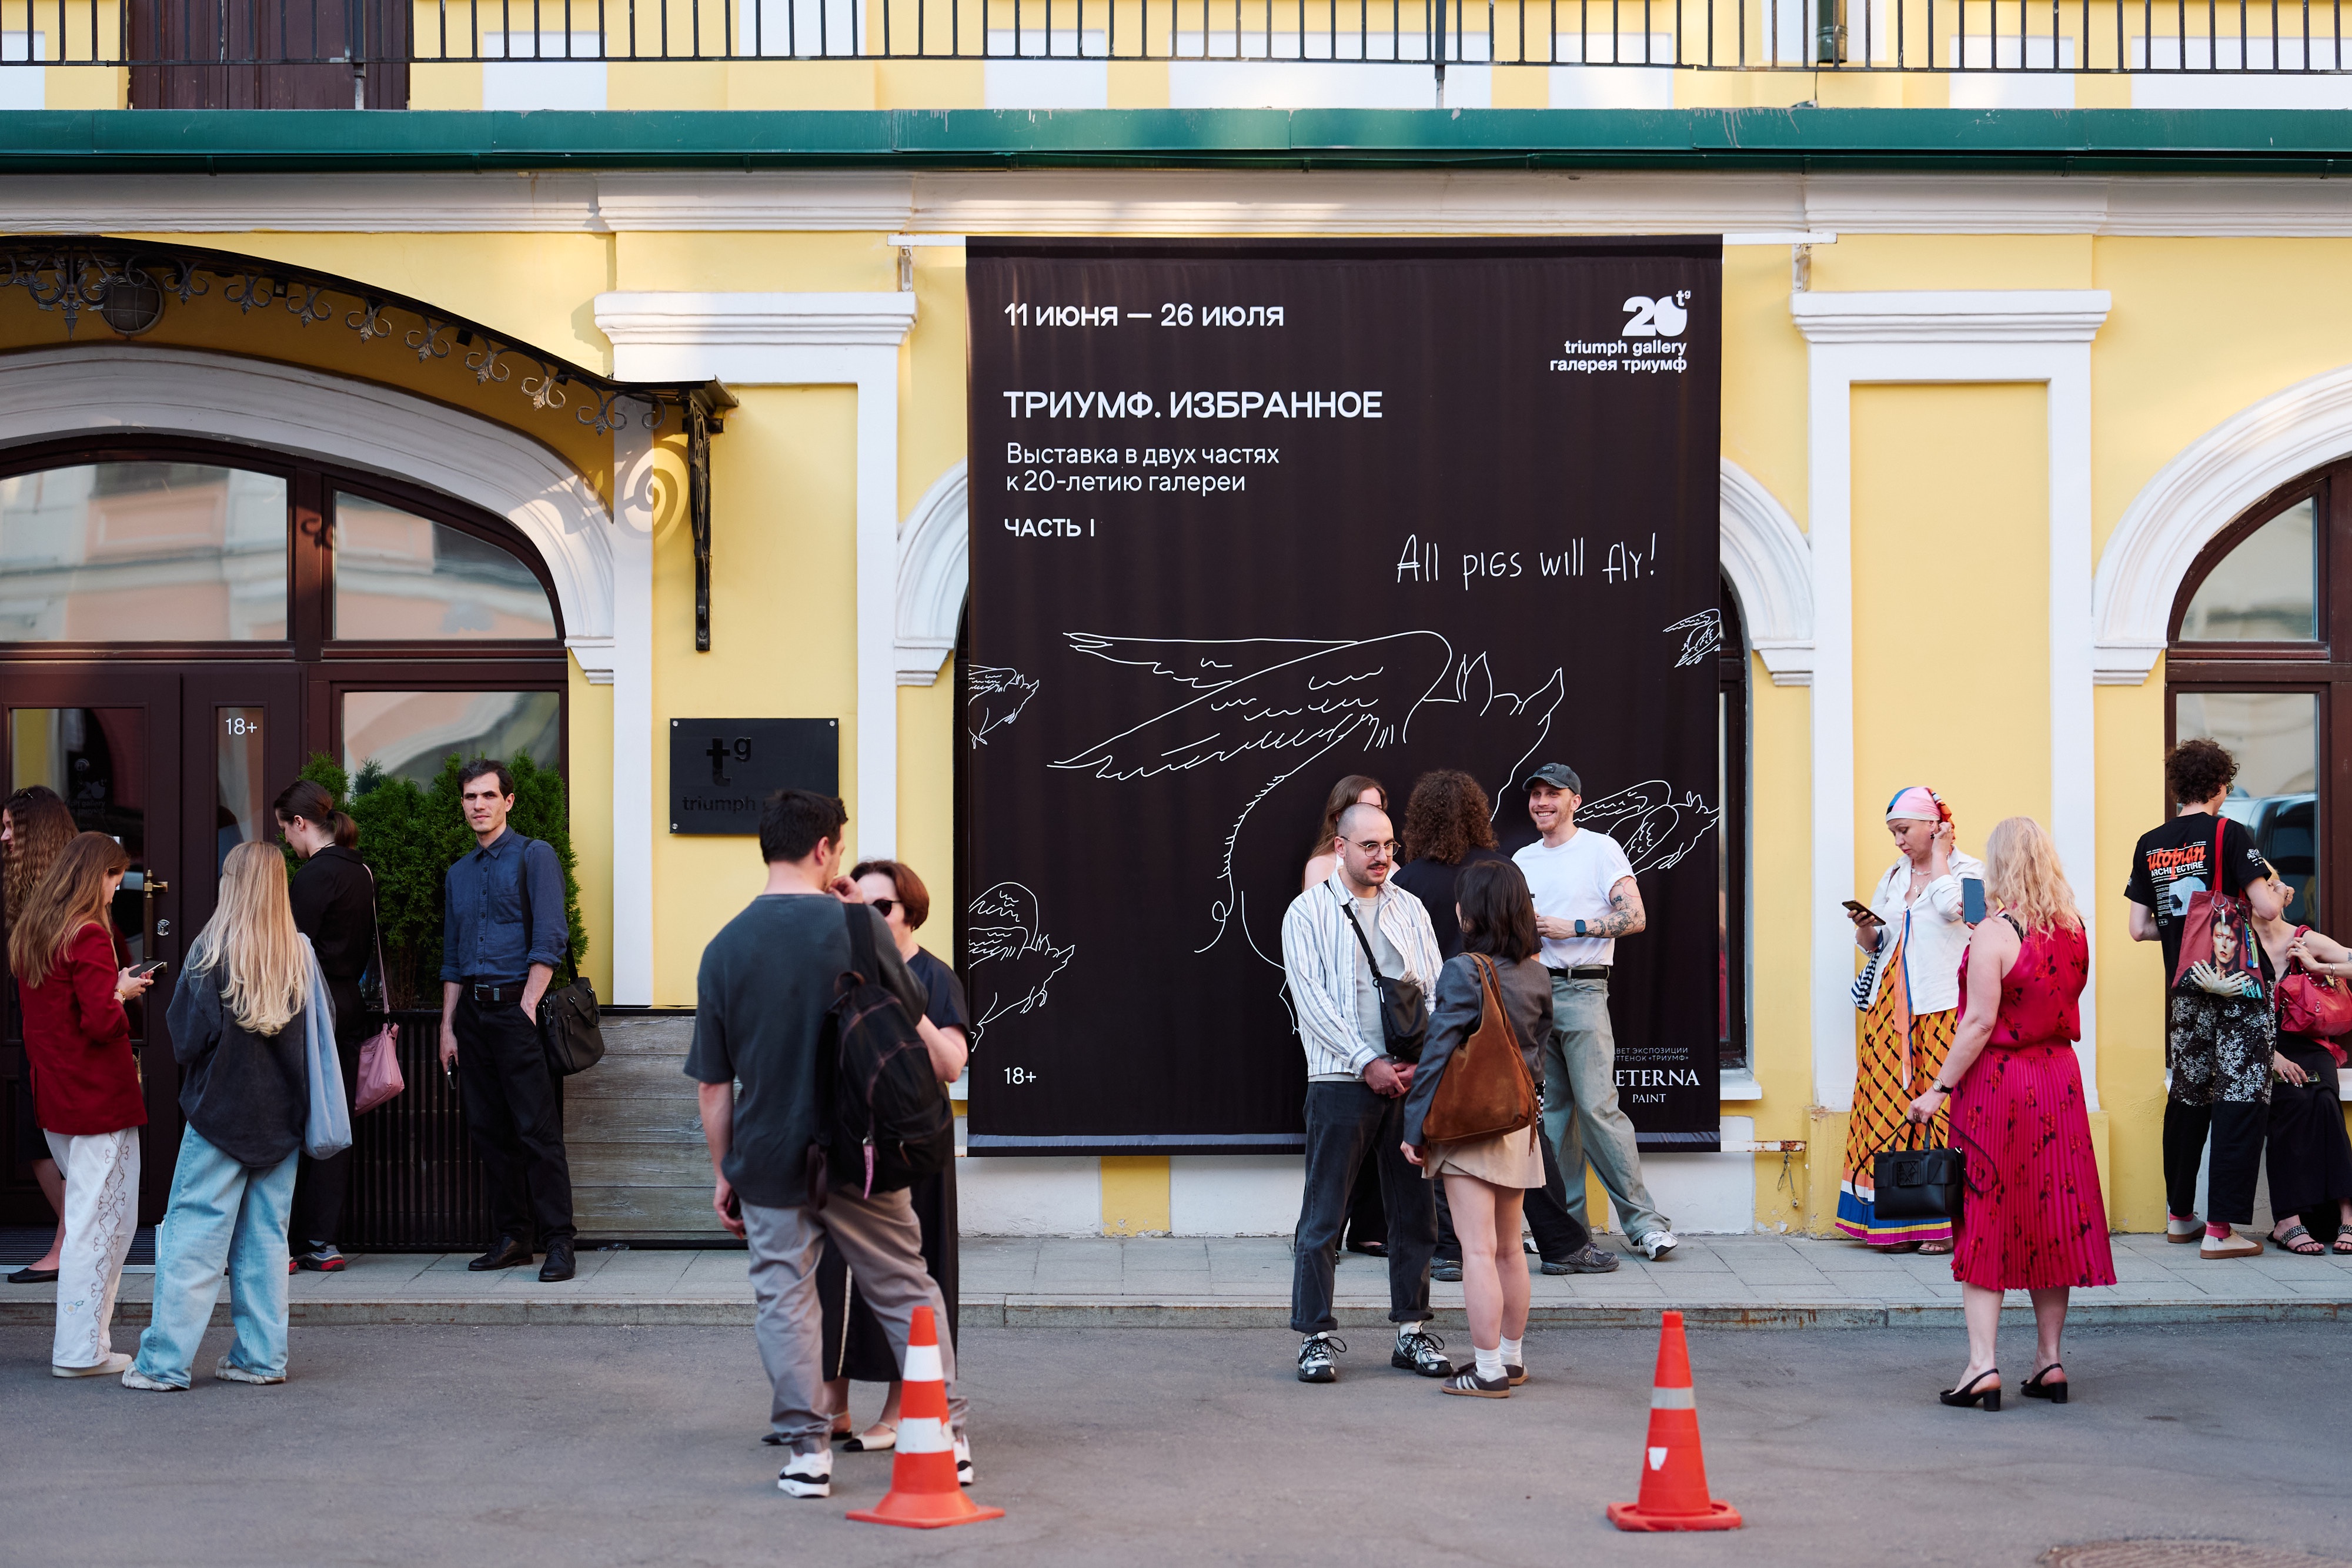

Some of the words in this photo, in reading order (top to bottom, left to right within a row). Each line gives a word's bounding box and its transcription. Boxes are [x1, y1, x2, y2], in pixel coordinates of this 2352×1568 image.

[1004, 303, 1027, 326] 11
[1035, 305, 1118, 327] ИЮНЯ
[1161, 303, 1194, 327] 26
[1202, 306, 1284, 327] ИЮЛЯ
[1622, 296, 1688, 337] 20
[1564, 339, 1628, 357] triumph
[1632, 339, 1687, 357] gallery
[1550, 359, 1618, 374] галерея
[1621, 356, 1687, 374] триумф
[1003, 391, 1161, 419] ТРИУМФ.
[1170, 391, 1383, 419] ИЗБРАННОЕ
[1007, 442, 1118, 464] Выставка
[1126, 448, 1137, 464] в
[1142, 448, 1197, 470] двух
[1202, 448, 1279, 464] частях
[1007, 476, 1019, 492] к
[1024, 470, 1142, 492] 20-летию
[1149, 476, 1245, 497] галереи
[1004, 519, 1081, 537] ЧАСТЬ
[1397, 534, 1439, 583] All
[225, 717, 258, 735] 18+
[682, 795, 756, 814] triumph
[1004, 1066, 1037, 1085] 18+
[1615, 1069, 1700, 1086] ETERNA
[1632, 1094, 1666, 1103] PAINT
